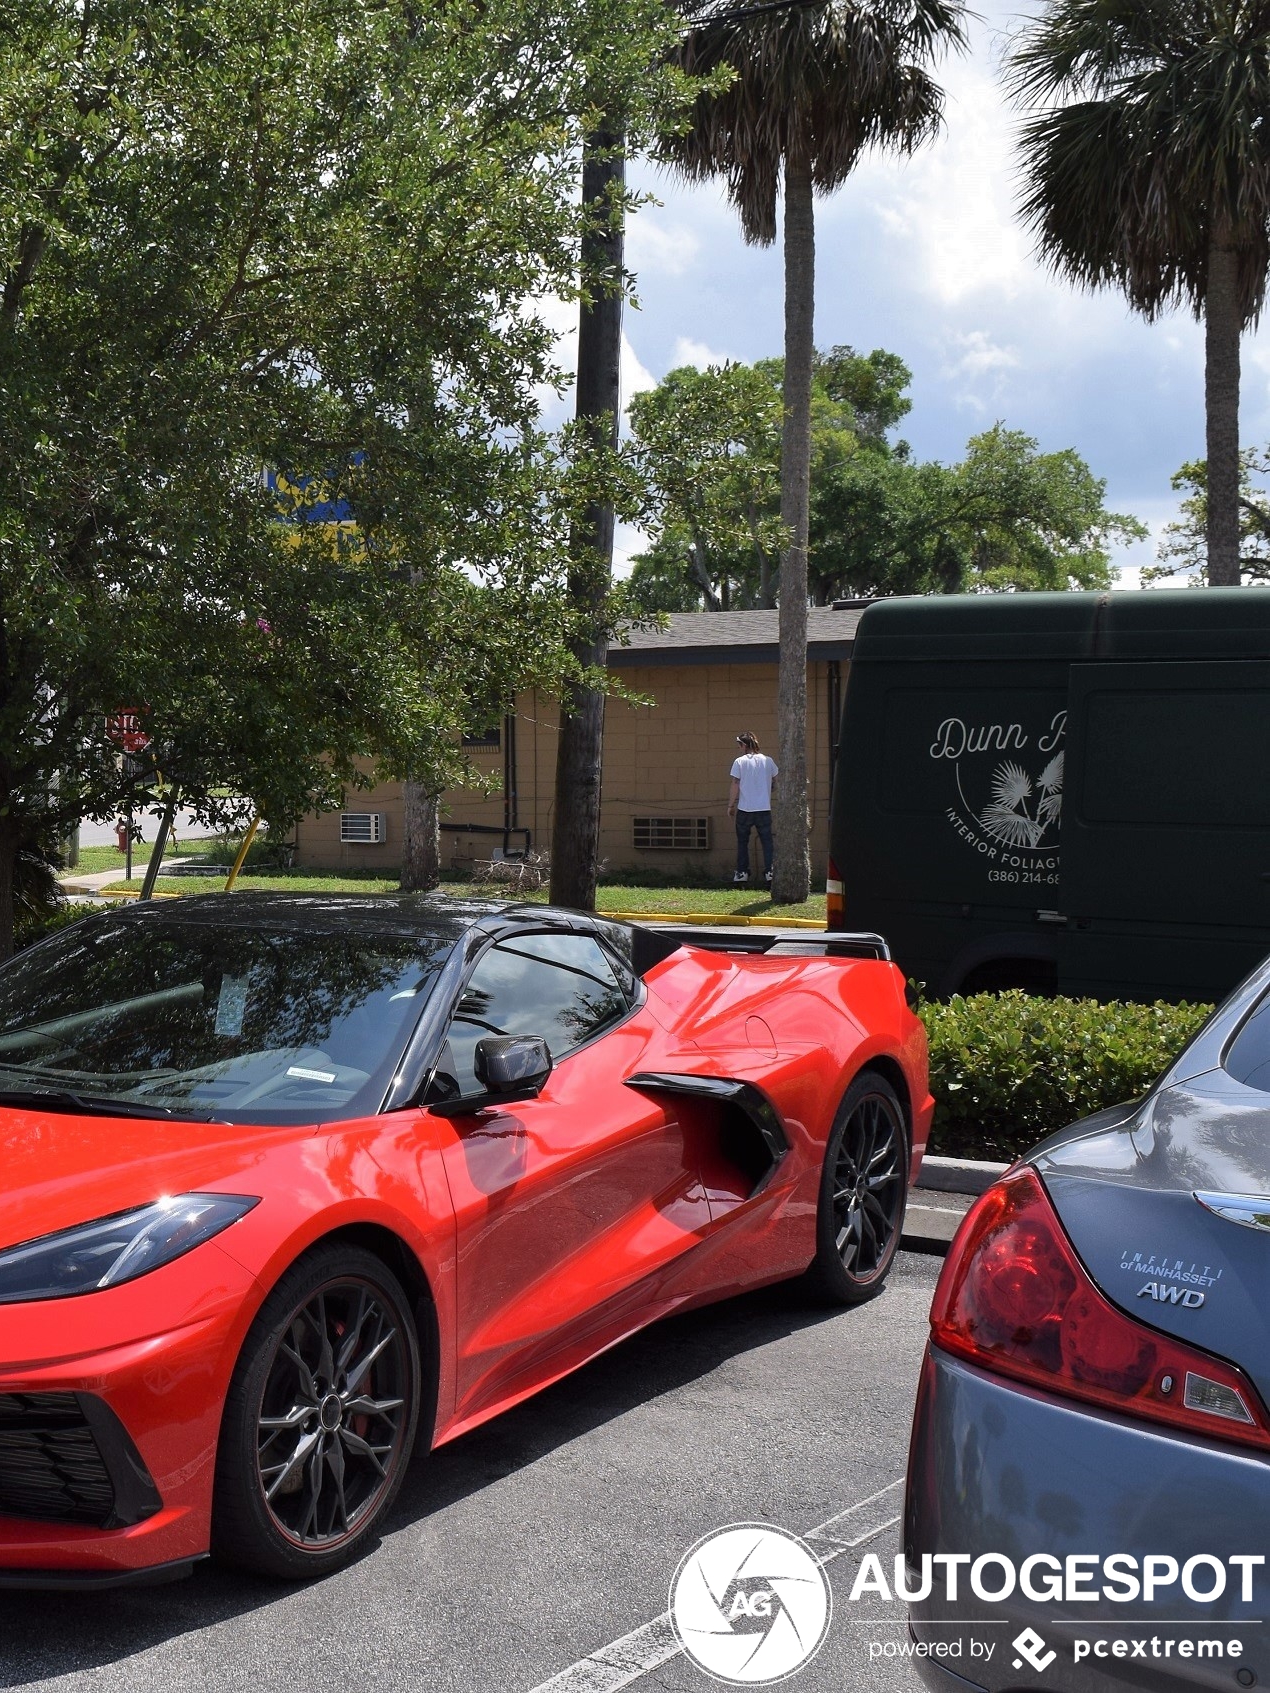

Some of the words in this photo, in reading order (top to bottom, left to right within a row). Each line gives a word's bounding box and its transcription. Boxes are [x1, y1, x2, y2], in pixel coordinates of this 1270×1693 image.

[929, 717, 1028, 759] Dunn
[944, 807, 998, 859] INTERIOR
[988, 869, 1019, 882] (386)
[1120, 1260, 1134, 1271] of
[1134, 1262, 1217, 1288] MANHASSET
[1121, 1250, 1223, 1279] INFINITI
[1136, 1281, 1206, 1309] AWD
